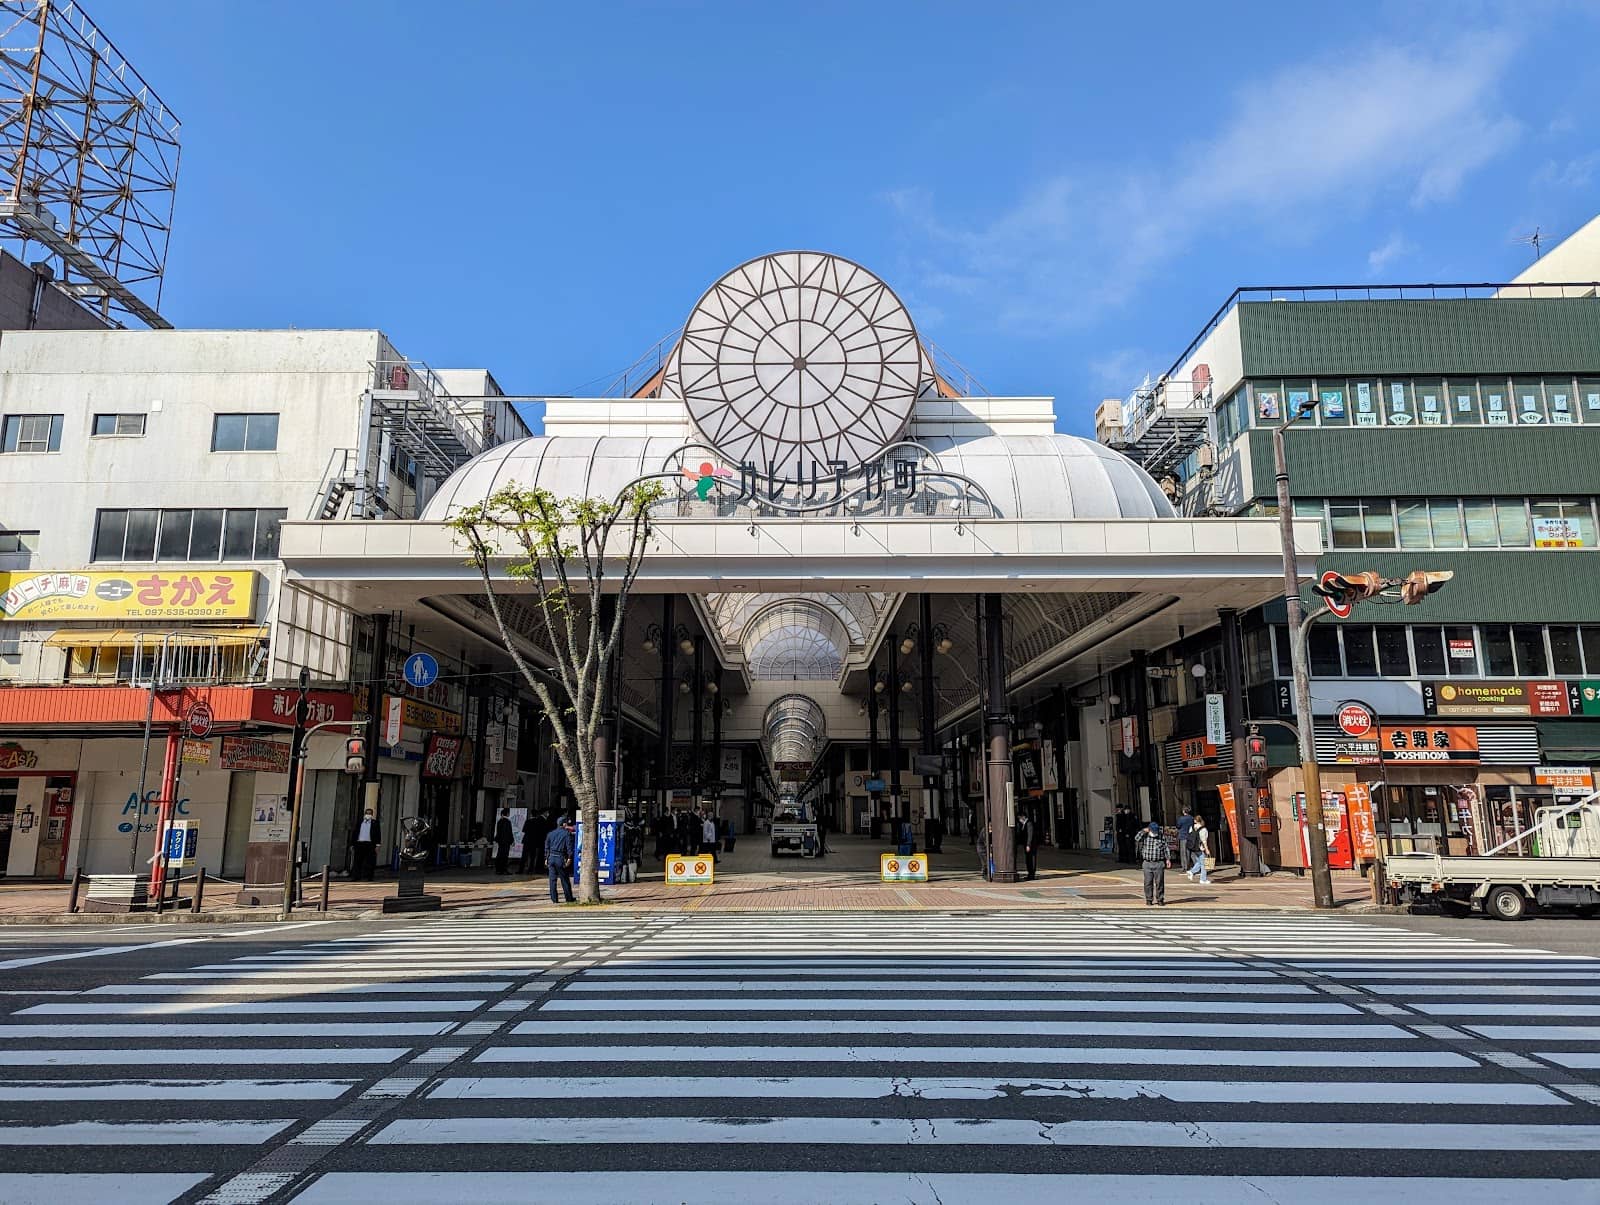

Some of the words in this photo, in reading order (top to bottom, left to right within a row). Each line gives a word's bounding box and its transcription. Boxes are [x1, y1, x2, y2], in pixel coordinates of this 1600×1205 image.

[737, 460, 918, 501] ガレリア竹町
[6, 577, 88, 606] リーチ麻雀
[136, 574, 236, 607] さかえ
[215, 608, 228, 616] 2F
[1458, 687, 1523, 696] homemade
[273, 694, 335, 722] 赤レガ通り
[1342, 715, 1369, 727] 消火栓
[1391, 730, 1450, 748] 吉野家
[7, 750, 38, 768] Ash
[1394, 752, 1450, 760] YOSHINOYA
[1547, 776, 1583, 786] 牛丼弁当
